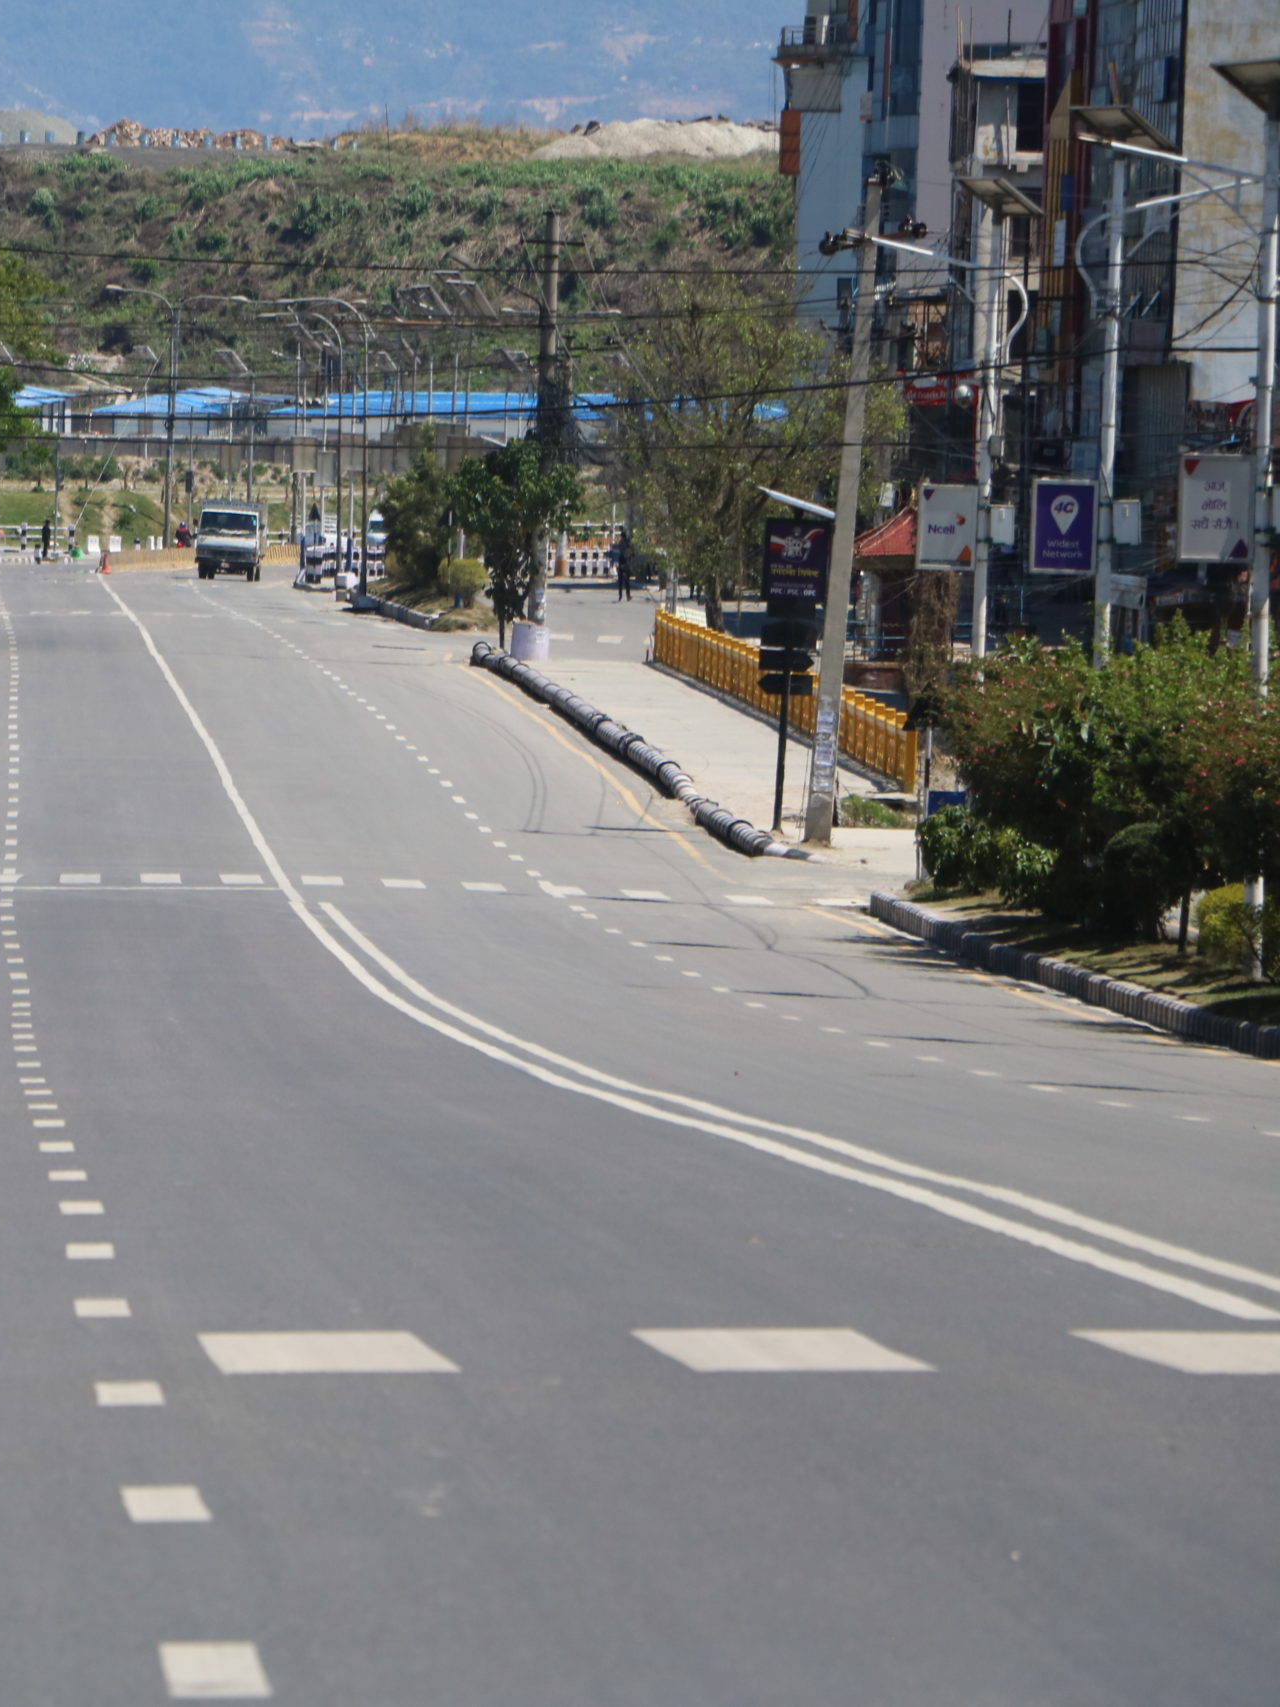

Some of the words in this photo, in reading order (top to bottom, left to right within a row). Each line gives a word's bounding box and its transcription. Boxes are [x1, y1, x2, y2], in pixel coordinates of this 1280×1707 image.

[1053, 502, 1076, 514] 4G
[927, 523, 956, 535] Ncell
[1047, 539, 1080, 549] Widest
[1042, 549, 1083, 559] Network
